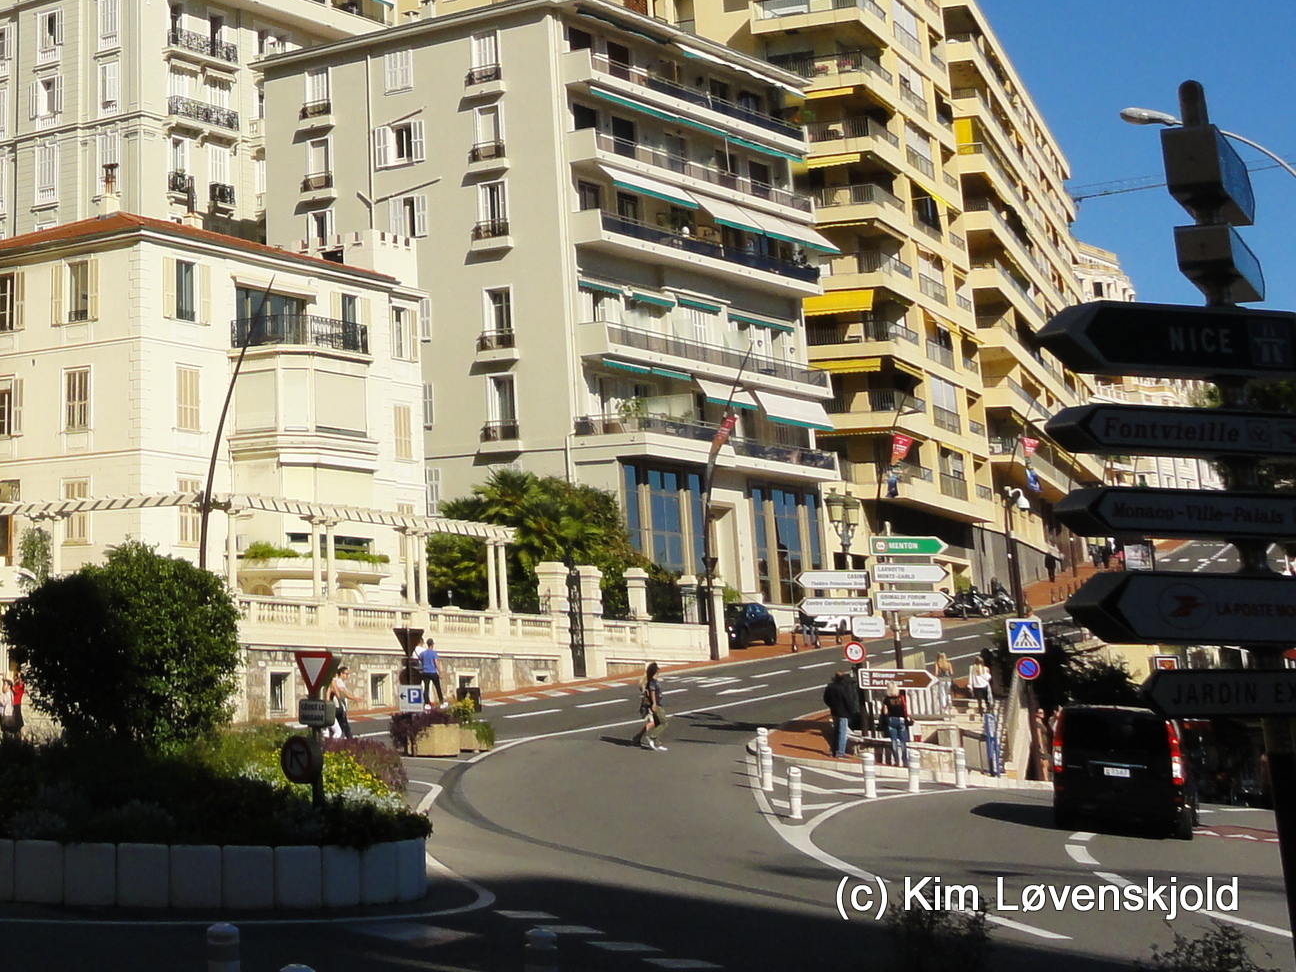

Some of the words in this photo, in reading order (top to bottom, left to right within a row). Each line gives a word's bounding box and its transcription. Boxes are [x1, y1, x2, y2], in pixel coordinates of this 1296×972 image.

[1169, 326, 1234, 354] NICE
[1103, 416, 1240, 443] Fontvieille
[888, 541, 919, 550] MENTON
[1215, 602, 1232, 616] LA
[1234, 602, 1274, 617] POSTE
[409, 689, 419, 703] P
[1172, 682, 1257, 705] JARDIN
